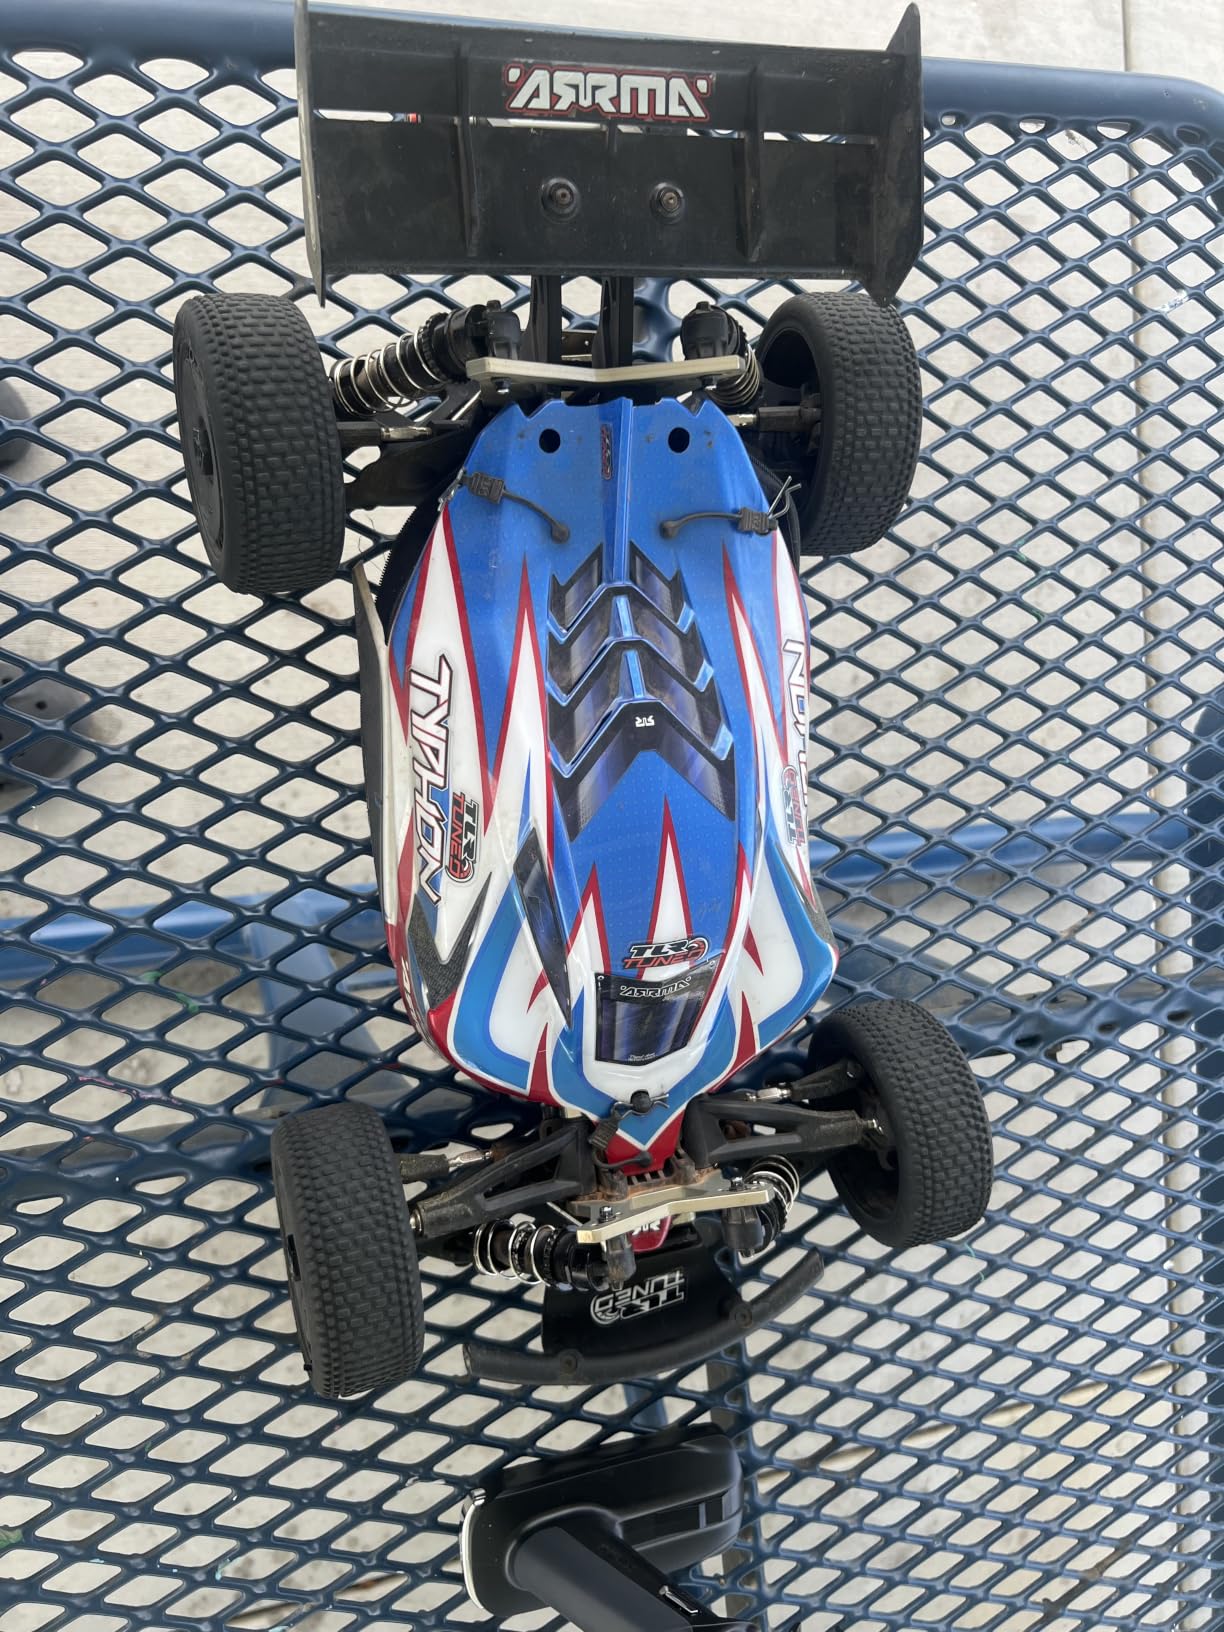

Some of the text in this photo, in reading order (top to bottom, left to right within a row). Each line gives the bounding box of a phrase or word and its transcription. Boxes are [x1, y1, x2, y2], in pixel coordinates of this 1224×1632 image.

[506, 66, 709, 119] ARRMA
[409, 653, 453, 907] TYPHON
[449, 792, 465, 878] TUNED
[461, 799, 479, 864] TLR
[624, 948, 705, 968] TUNED
[629, 939, 689, 959] TLR
[594, 1270, 685, 1313] TUNED
[620, 1284, 685, 1320] TLR
